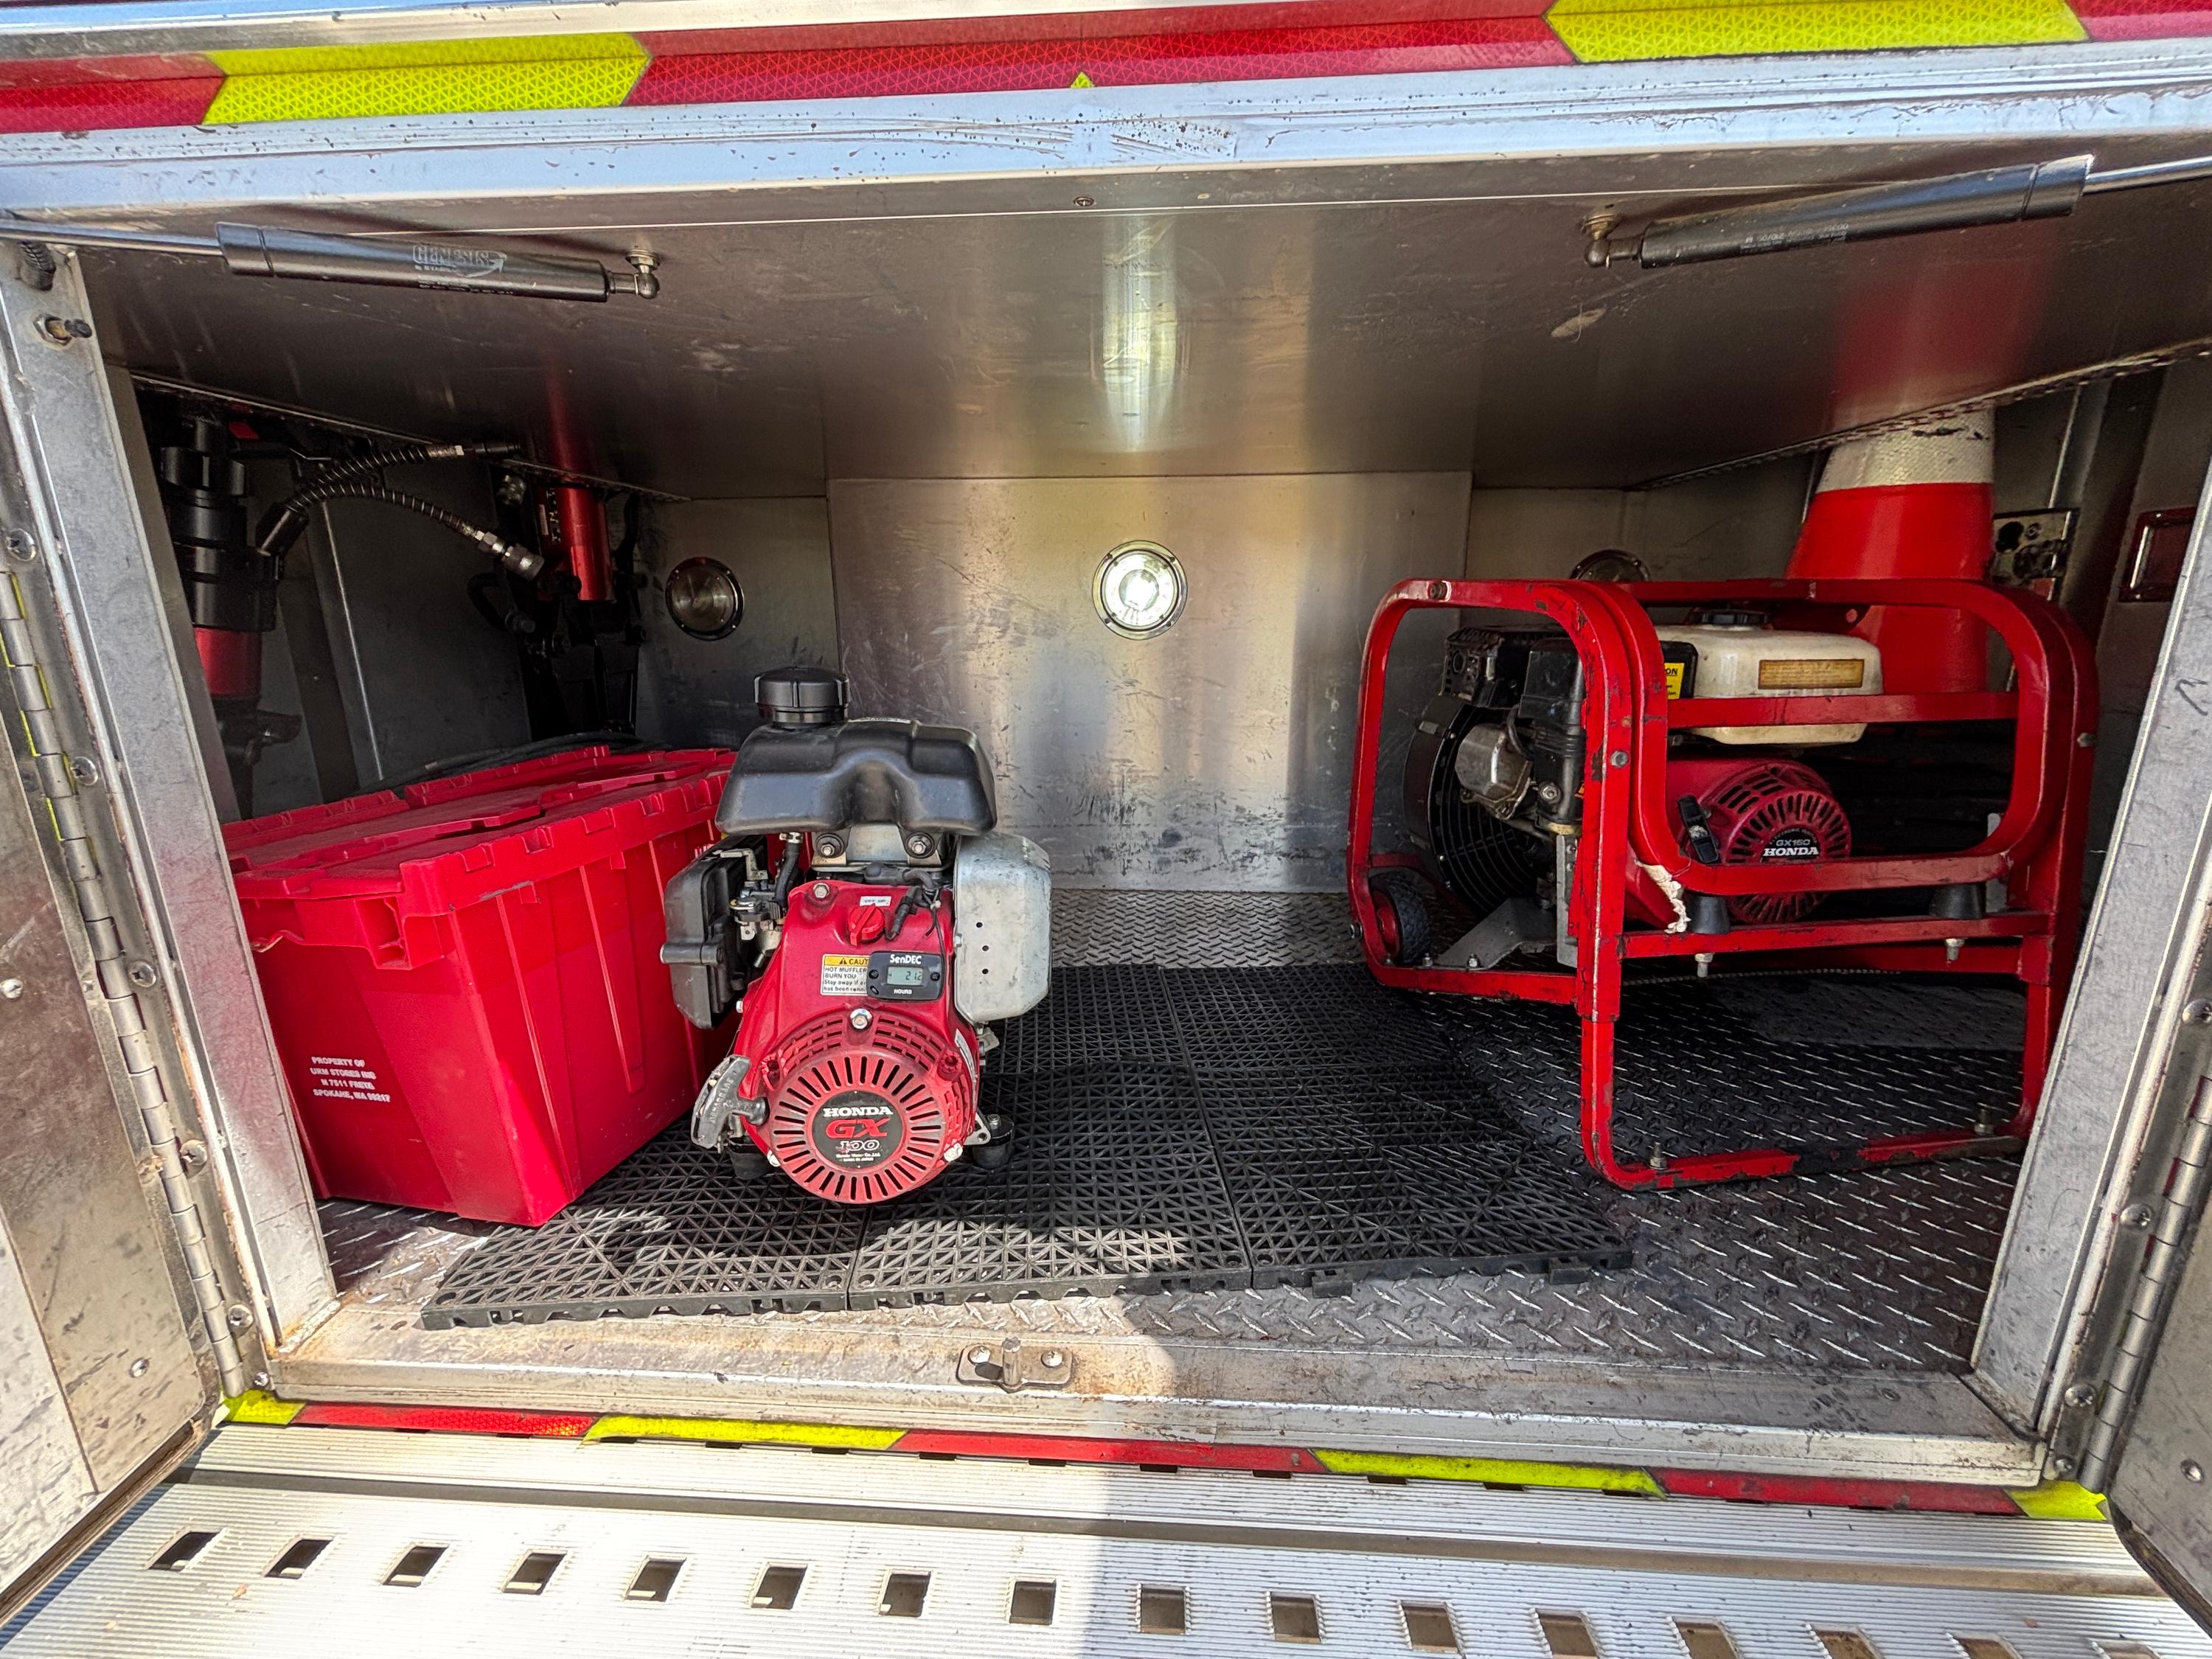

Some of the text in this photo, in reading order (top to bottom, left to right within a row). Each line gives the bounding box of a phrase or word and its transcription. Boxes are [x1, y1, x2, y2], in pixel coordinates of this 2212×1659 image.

[1763, 846, 1819, 856] HONDA
[890, 953, 922, 965] SenDEC
[311, 1057, 353, 1066] PROPERTY
[310, 1068, 330, 1076] URM
[329, 1079, 348, 1088] 7511
[313, 1089, 354, 1100] SPOKANE,
[823, 1107, 894, 1118] HONDA
[825, 1117, 891, 1139] GX
